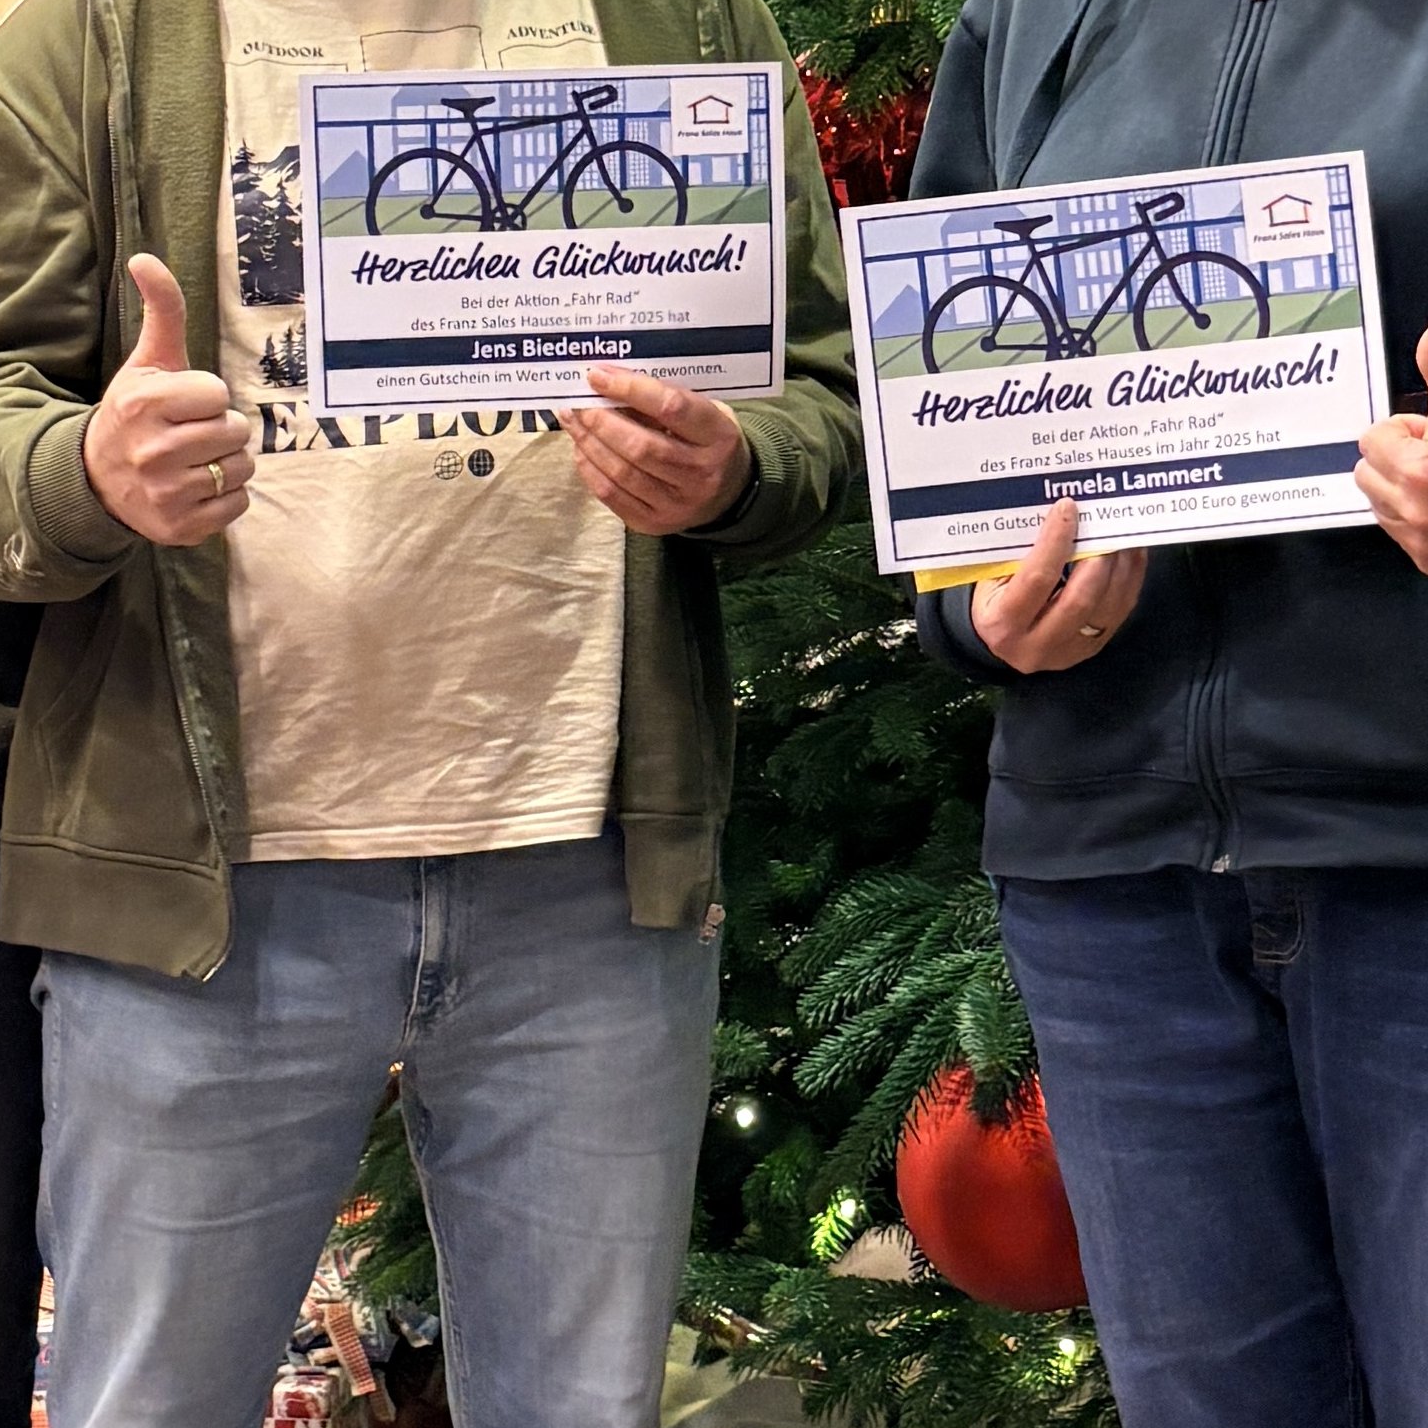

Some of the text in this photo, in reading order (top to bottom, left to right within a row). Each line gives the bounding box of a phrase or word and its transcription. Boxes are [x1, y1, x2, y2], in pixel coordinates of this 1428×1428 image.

[242, 42, 325, 58] OUTDOOR
[352, 233, 747, 285] Herzlichen Glückwunsch!
[461, 296, 482, 309] Bei
[487, 295, 509, 309] der
[514, 294, 559, 308] Aktion
[411, 310, 690, 331] des Franz Sales Hauses im Jahr 2025 hat
[472, 336, 632, 359] Jens Biedenkap
[377, 375, 415, 388] einen
[420, 372, 490, 386] Gutschein
[495, 371, 511, 383] im
[516, 370, 550, 382] Wert
[556, 370, 581, 381] von
[651, 365, 727, 379] gewonnen.
[912, 342, 1338, 426] Herzlichen Glückwunsch!
[1032, 431, 1055, 446] Bei
[1060, 429, 1084, 443] der
[1089, 423, 1138, 440] Aktion
[980, 430, 1281, 473] des Franz Sales Hauses im Jahr 2025 hat
[1044, 463, 1223, 499] Irmela Lammert
[947, 521, 989, 537] einen
[993, 513, 1046, 531] Gutsch
[1096, 503, 1134, 520] Wert
[1138, 501, 1164, 515] von
[1171, 497, 1197, 513] 100
[1202, 493, 1236, 509] Euro
[1240, 486, 1325, 508] gewonnen.
